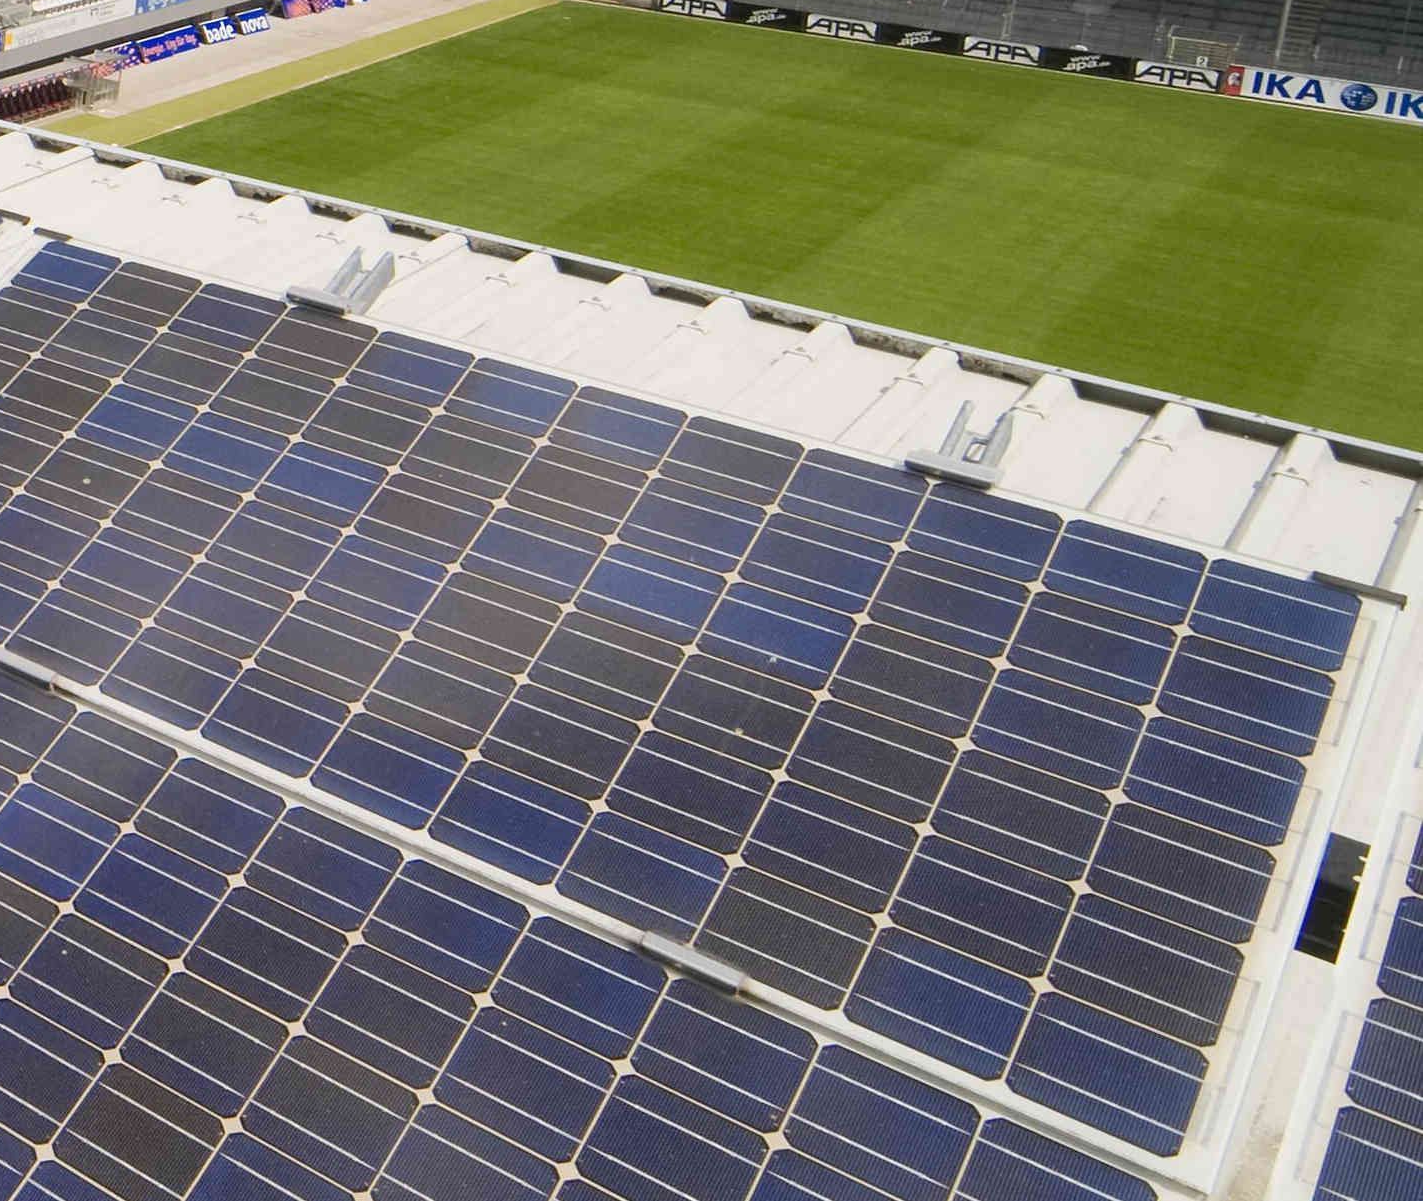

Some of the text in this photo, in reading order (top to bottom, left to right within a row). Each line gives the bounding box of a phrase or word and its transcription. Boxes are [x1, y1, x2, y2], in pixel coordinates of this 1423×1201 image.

[203, 16, 269, 43] bade nova
[806, 18, 876, 39] APA
[963, 41, 1040, 63] APA
[1134, 65, 1218, 90] APA
[1252, 71, 1325, 104] IKA
